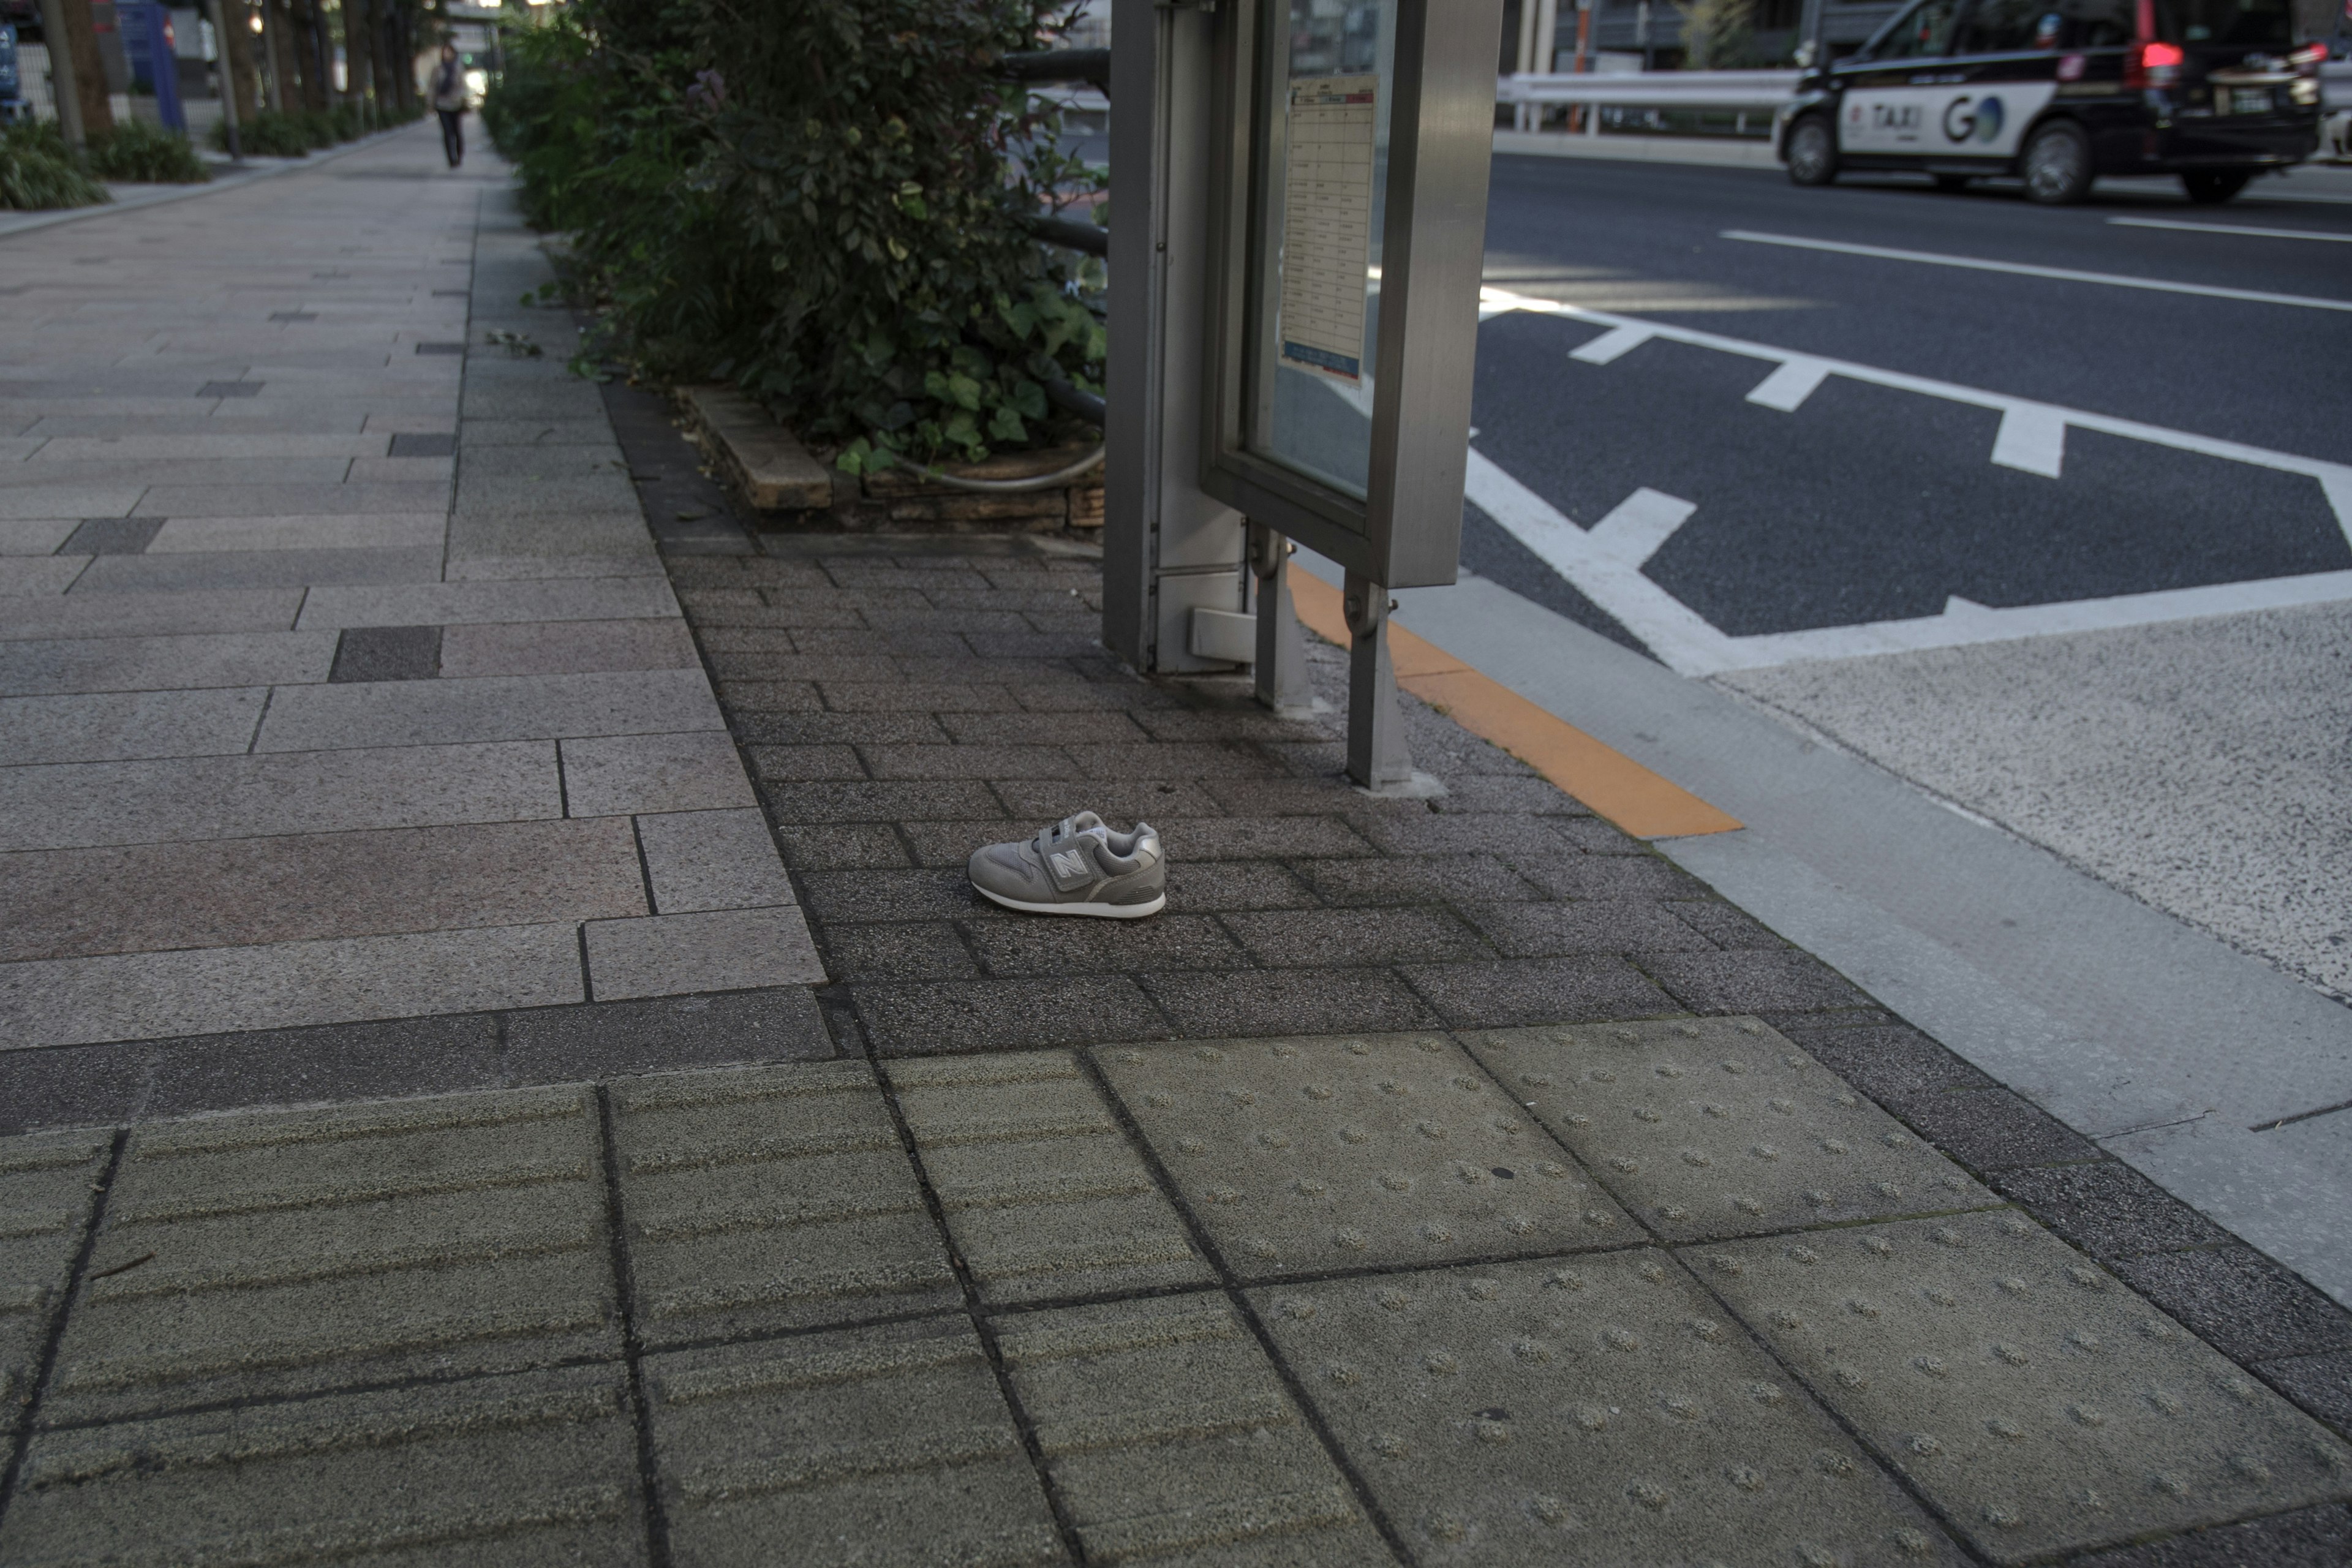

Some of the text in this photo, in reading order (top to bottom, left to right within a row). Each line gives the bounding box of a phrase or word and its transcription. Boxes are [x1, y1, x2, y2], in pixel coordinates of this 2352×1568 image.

[1872, 104, 1921, 129] TAXI
[1942, 96, 2004, 144] GO
[1050, 850, 1088, 878] N
